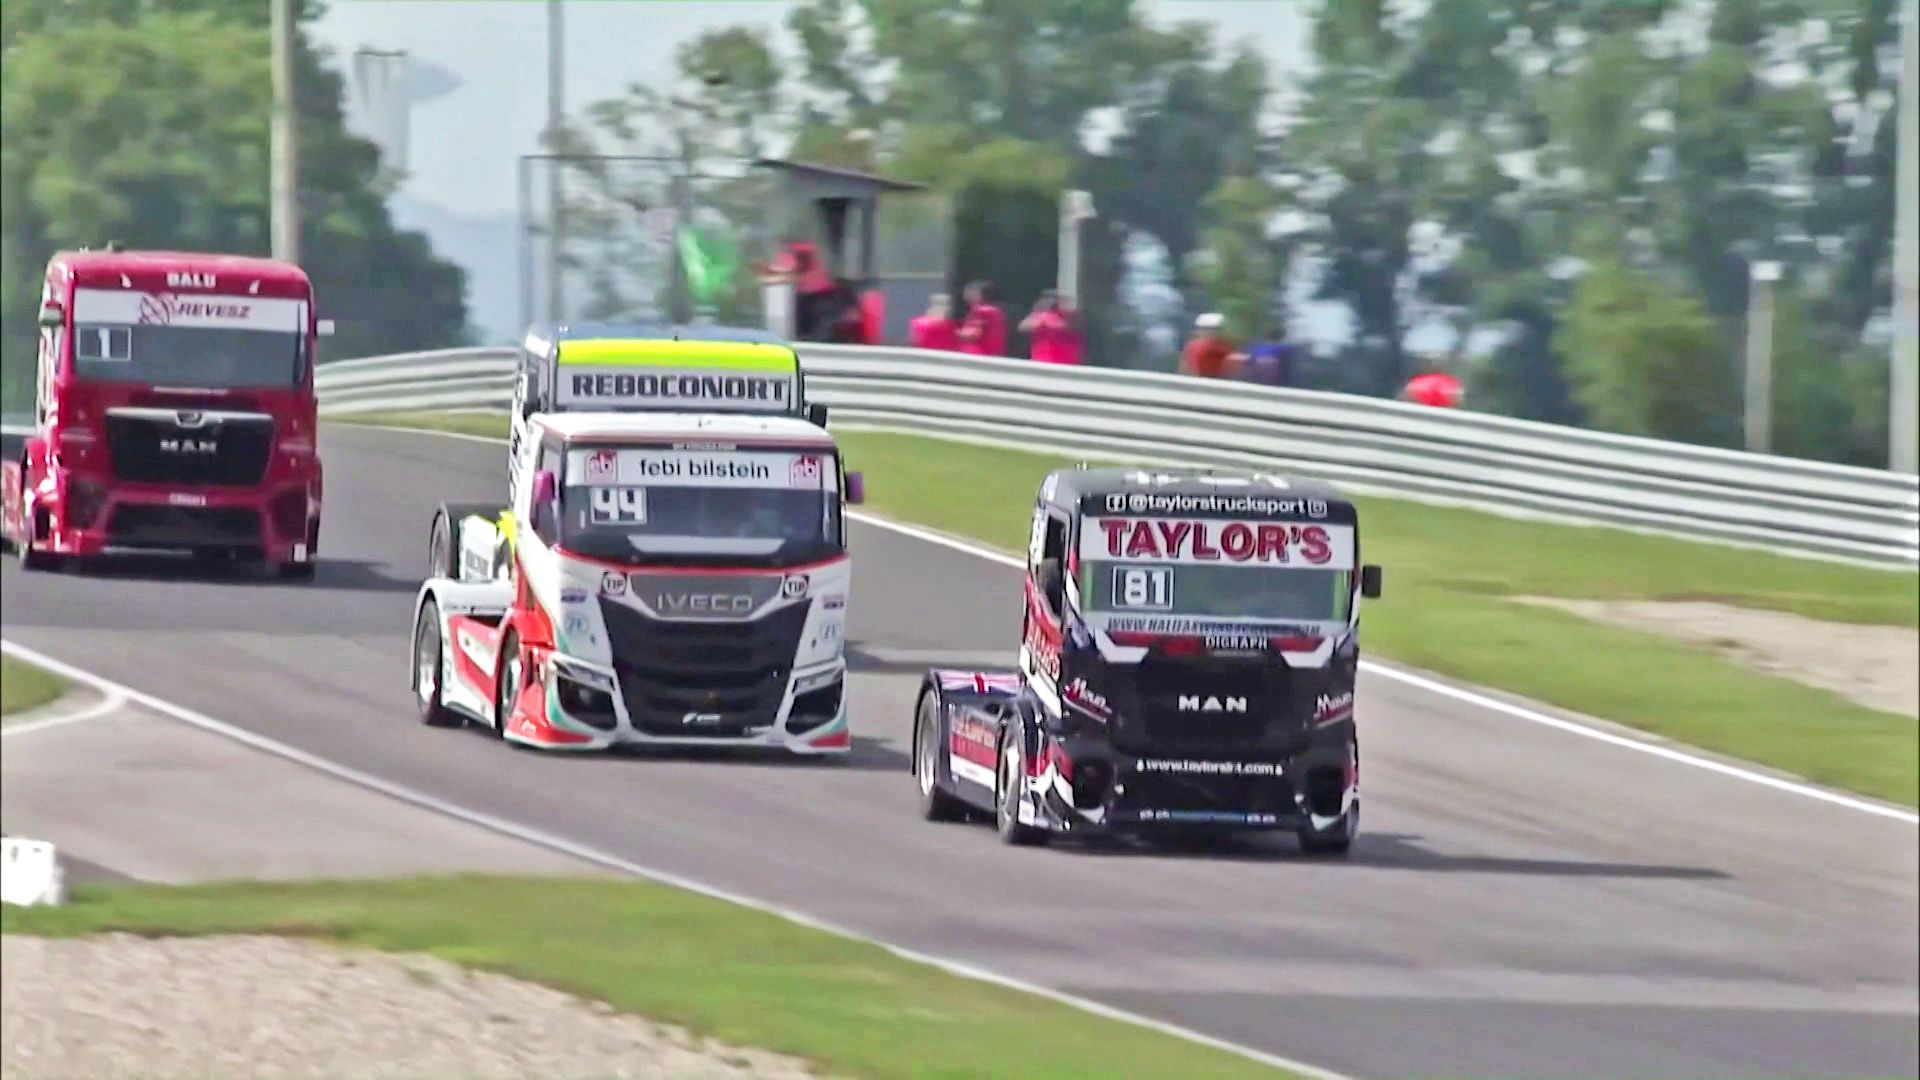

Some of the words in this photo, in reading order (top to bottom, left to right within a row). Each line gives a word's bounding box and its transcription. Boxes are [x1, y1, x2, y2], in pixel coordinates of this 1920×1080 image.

[166, 272, 217, 289] BALU
[98, 327, 110, 359] 1
[572, 374, 788, 401] REBOCONORT
[160, 439, 217, 453] MAN
[640, 459, 681, 476] febi
[689, 459, 770, 479] bilstein
[1100, 518, 1333, 564] TAYLOR'S
[1124, 570, 1165, 604] 81
[657, 593, 753, 610] IVECO
[1177, 695, 1248, 712] MAN
